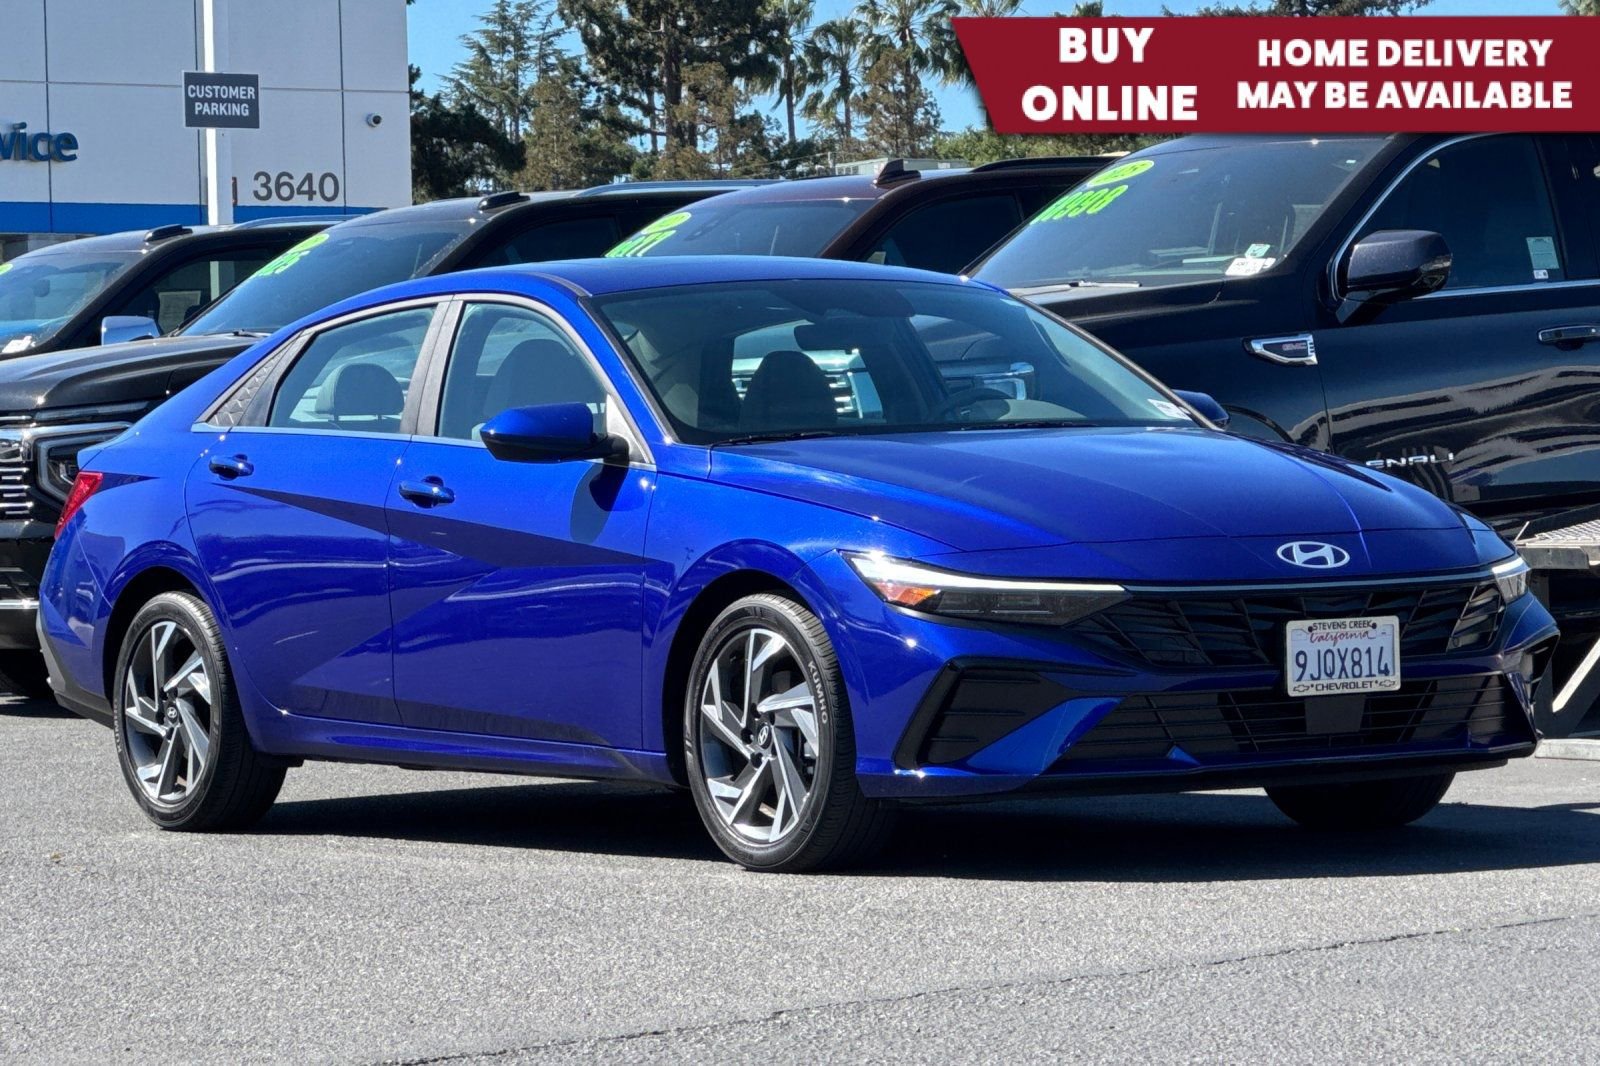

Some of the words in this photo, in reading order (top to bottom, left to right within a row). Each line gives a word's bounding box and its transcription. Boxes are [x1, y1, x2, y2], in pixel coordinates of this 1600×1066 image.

[187, 84, 256, 100] CUSTOMER
[194, 102, 250, 117] PARKING
[252, 171, 340, 202] 3640
[1365, 452, 1454, 469] ENALI
[1312, 621, 1347, 631] STEVENS
[1348, 620, 1373, 629] CREEK
[1309, 630, 1377, 647] California
[1295, 646, 1391, 682] 9JQX814
[808, 660, 829, 724] KUMHO
[1315, 680, 1374, 692] CHEVROLET
